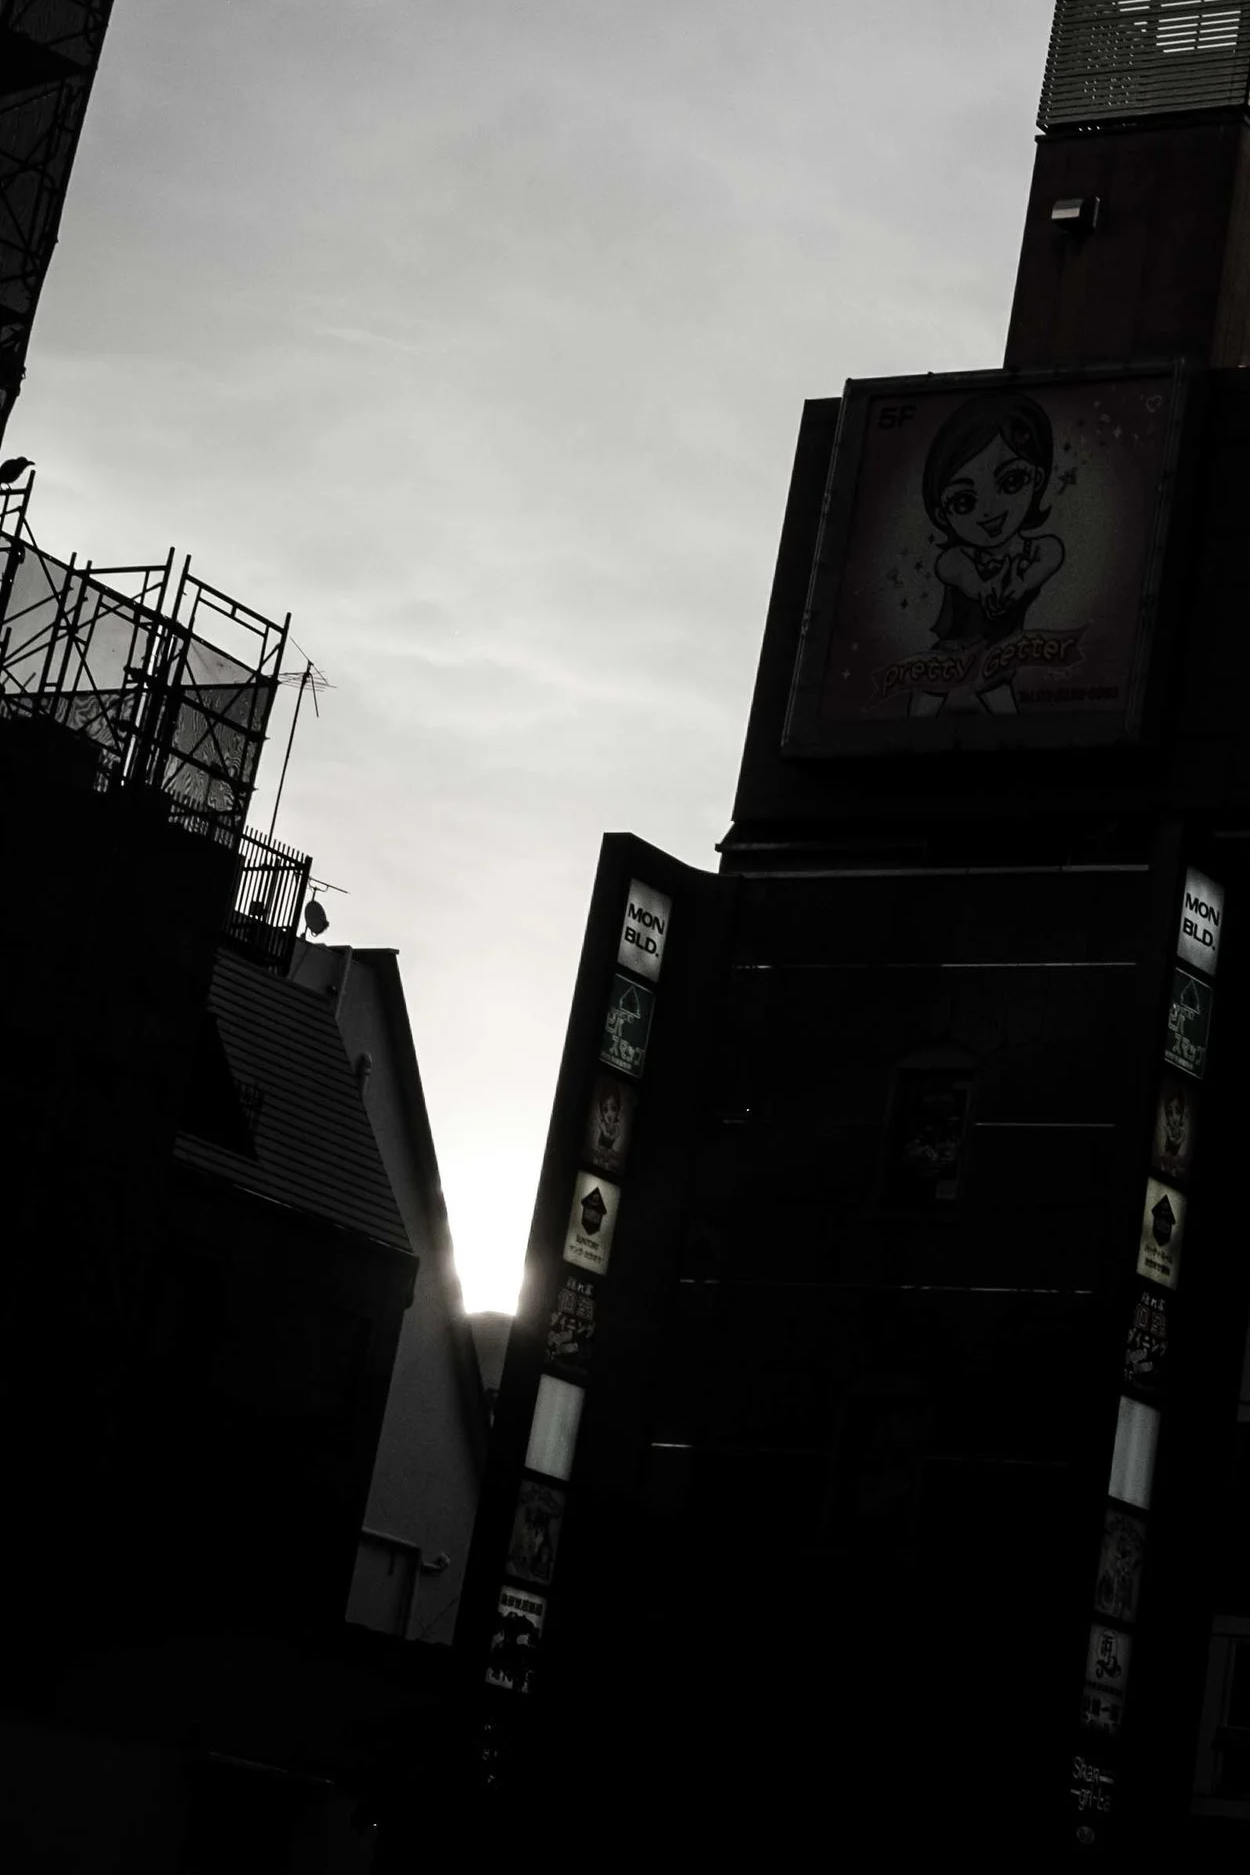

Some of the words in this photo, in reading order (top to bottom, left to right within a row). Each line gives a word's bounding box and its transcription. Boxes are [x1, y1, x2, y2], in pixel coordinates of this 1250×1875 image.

[628, 903, 666, 936] MON
[1185, 892, 1220, 925] MON
[624, 927, 660, 958] BLD.
[1182, 920, 1216, 951] BLD.
